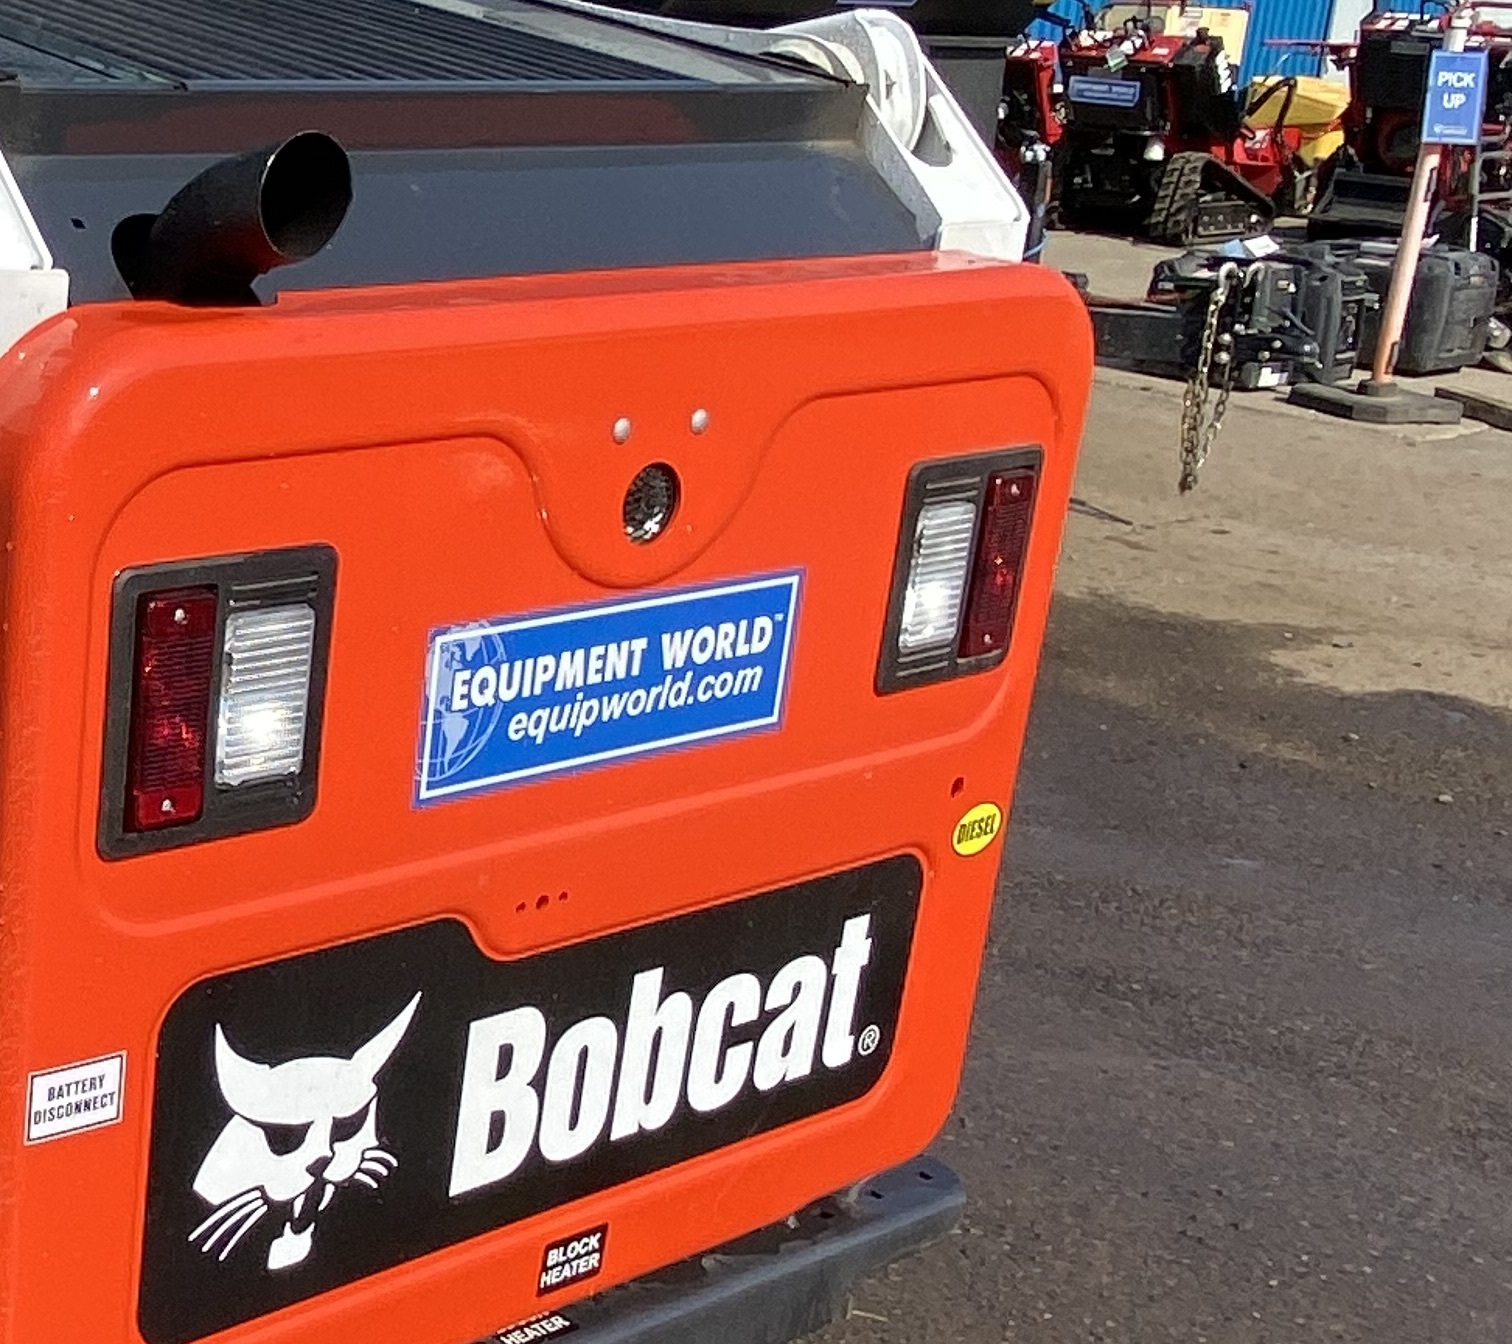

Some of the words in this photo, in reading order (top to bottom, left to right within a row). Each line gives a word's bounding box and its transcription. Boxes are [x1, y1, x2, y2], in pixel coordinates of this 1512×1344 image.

[1436, 71, 1476, 88] PICK
[1442, 92, 1467, 109] UP
[450, 637, 648, 712] EQUIPMENT
[506, 665, 764, 744] equipworld.com
[956, 812, 997, 846] DIESEL
[47, 1074, 106, 1102] BATTERY
[33, 1091, 116, 1125] DISCONNECT
[546, 1232, 602, 1267] BLOCK
[539, 1252, 601, 1289] HEATER
